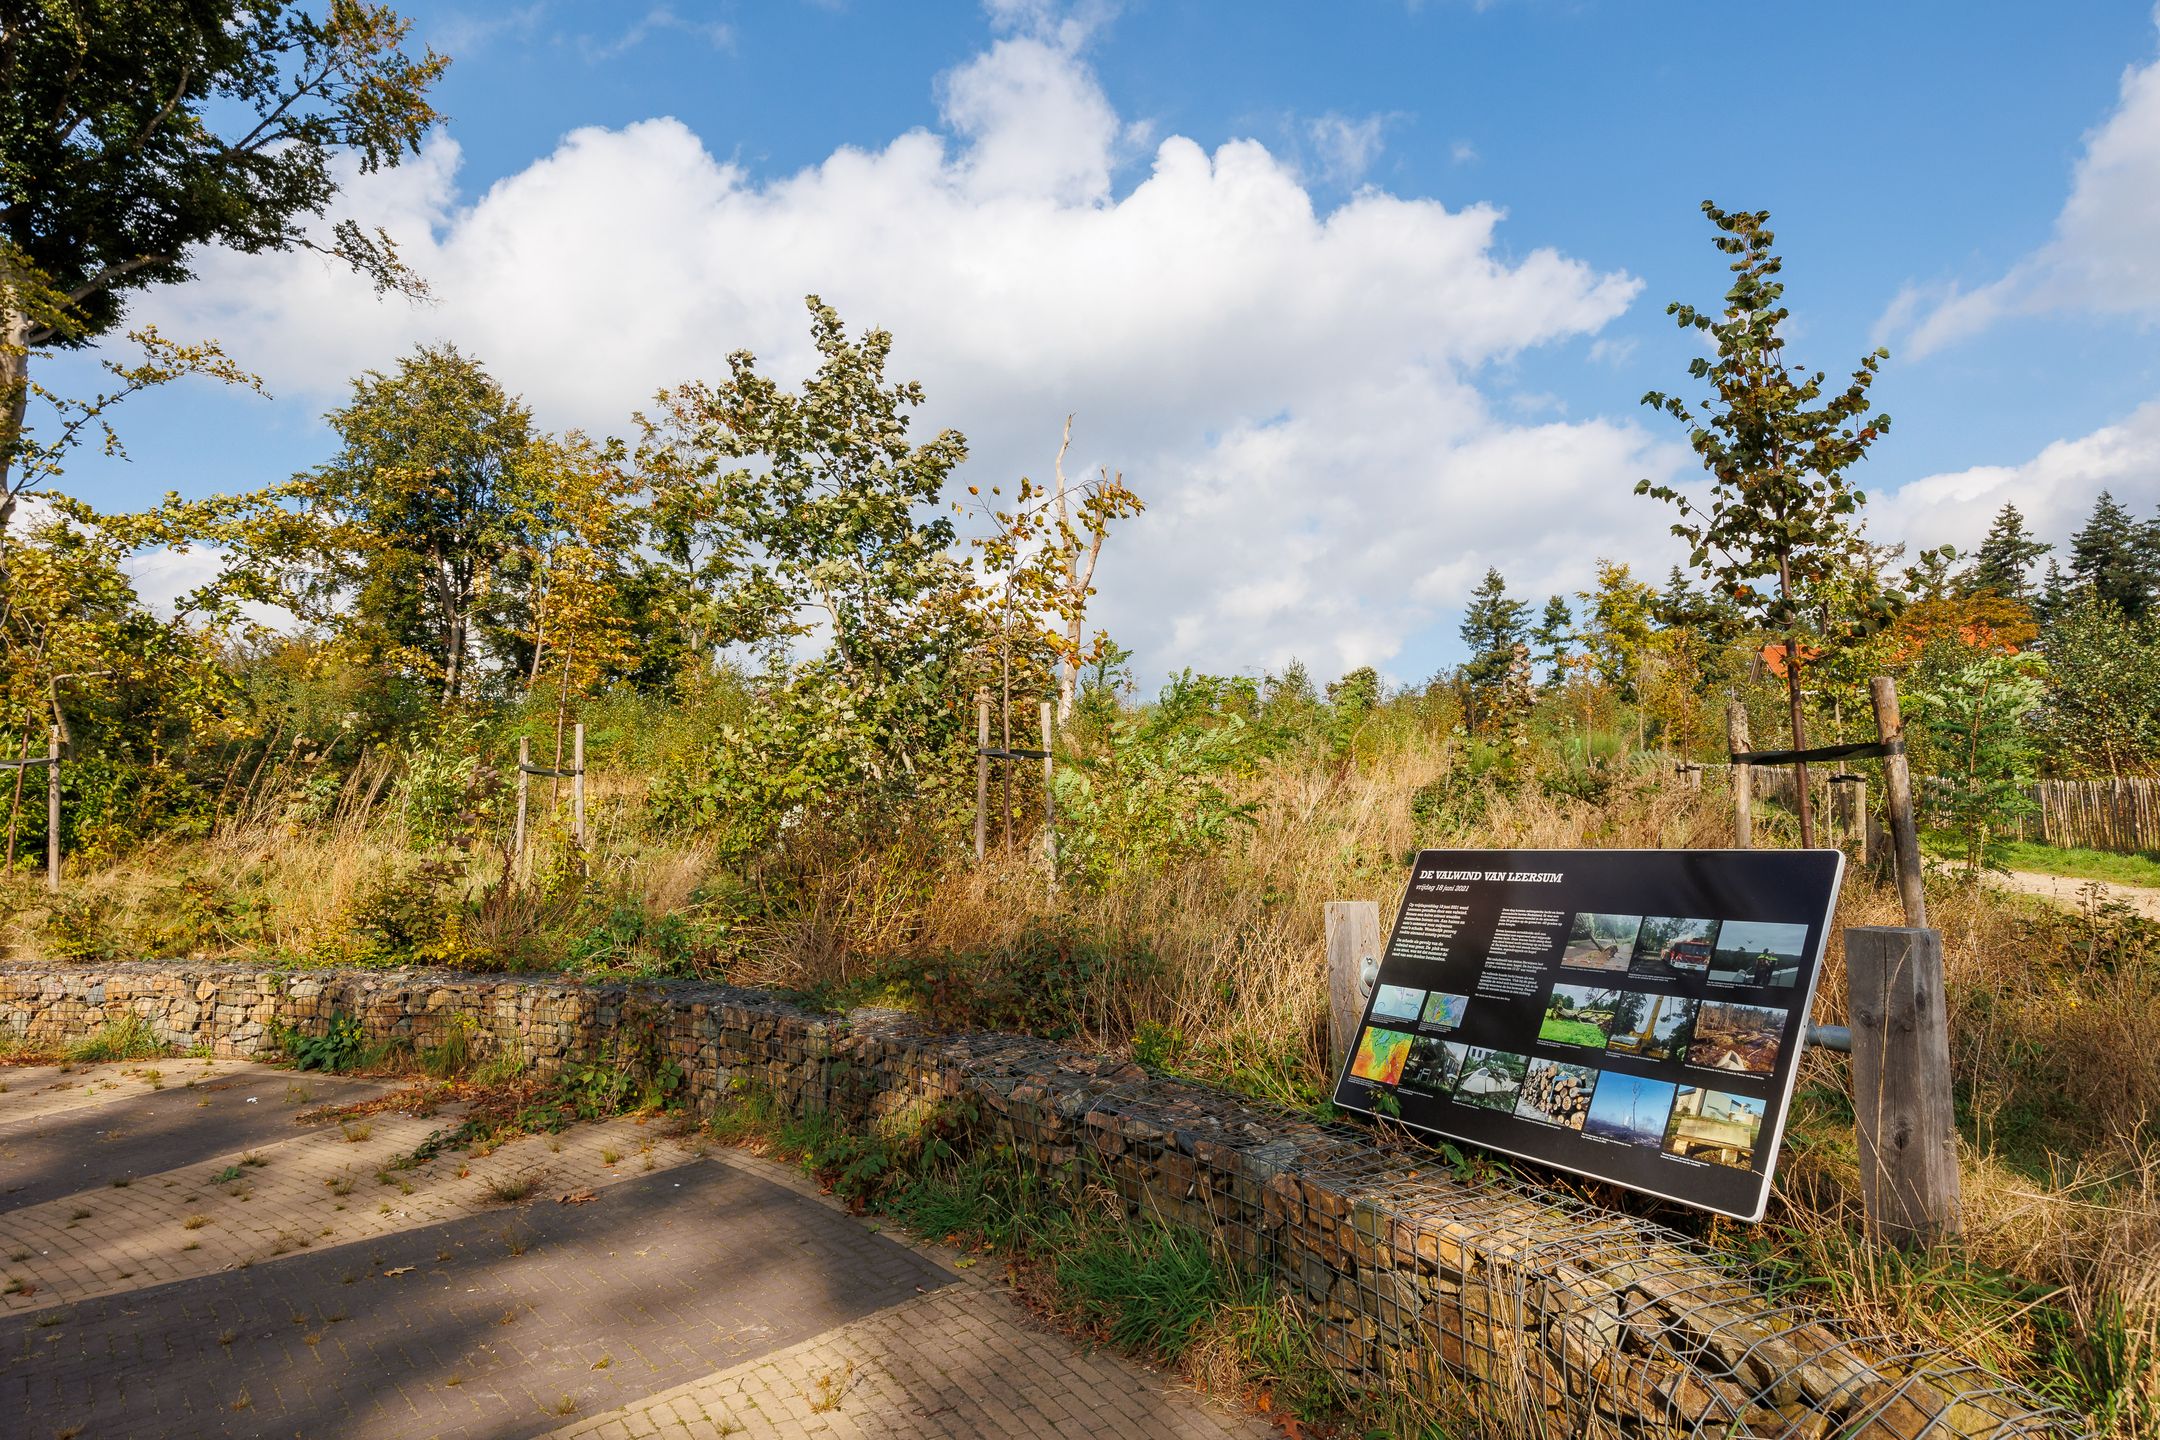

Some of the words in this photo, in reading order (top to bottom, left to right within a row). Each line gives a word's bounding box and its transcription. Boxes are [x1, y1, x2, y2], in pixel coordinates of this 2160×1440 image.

[1420, 871, 1434, 879] DE
[1436, 871, 1481, 880] VALWIND
[1484, 872, 1506, 881] VAN
[1507, 872, 1563, 882] LEERSUM
